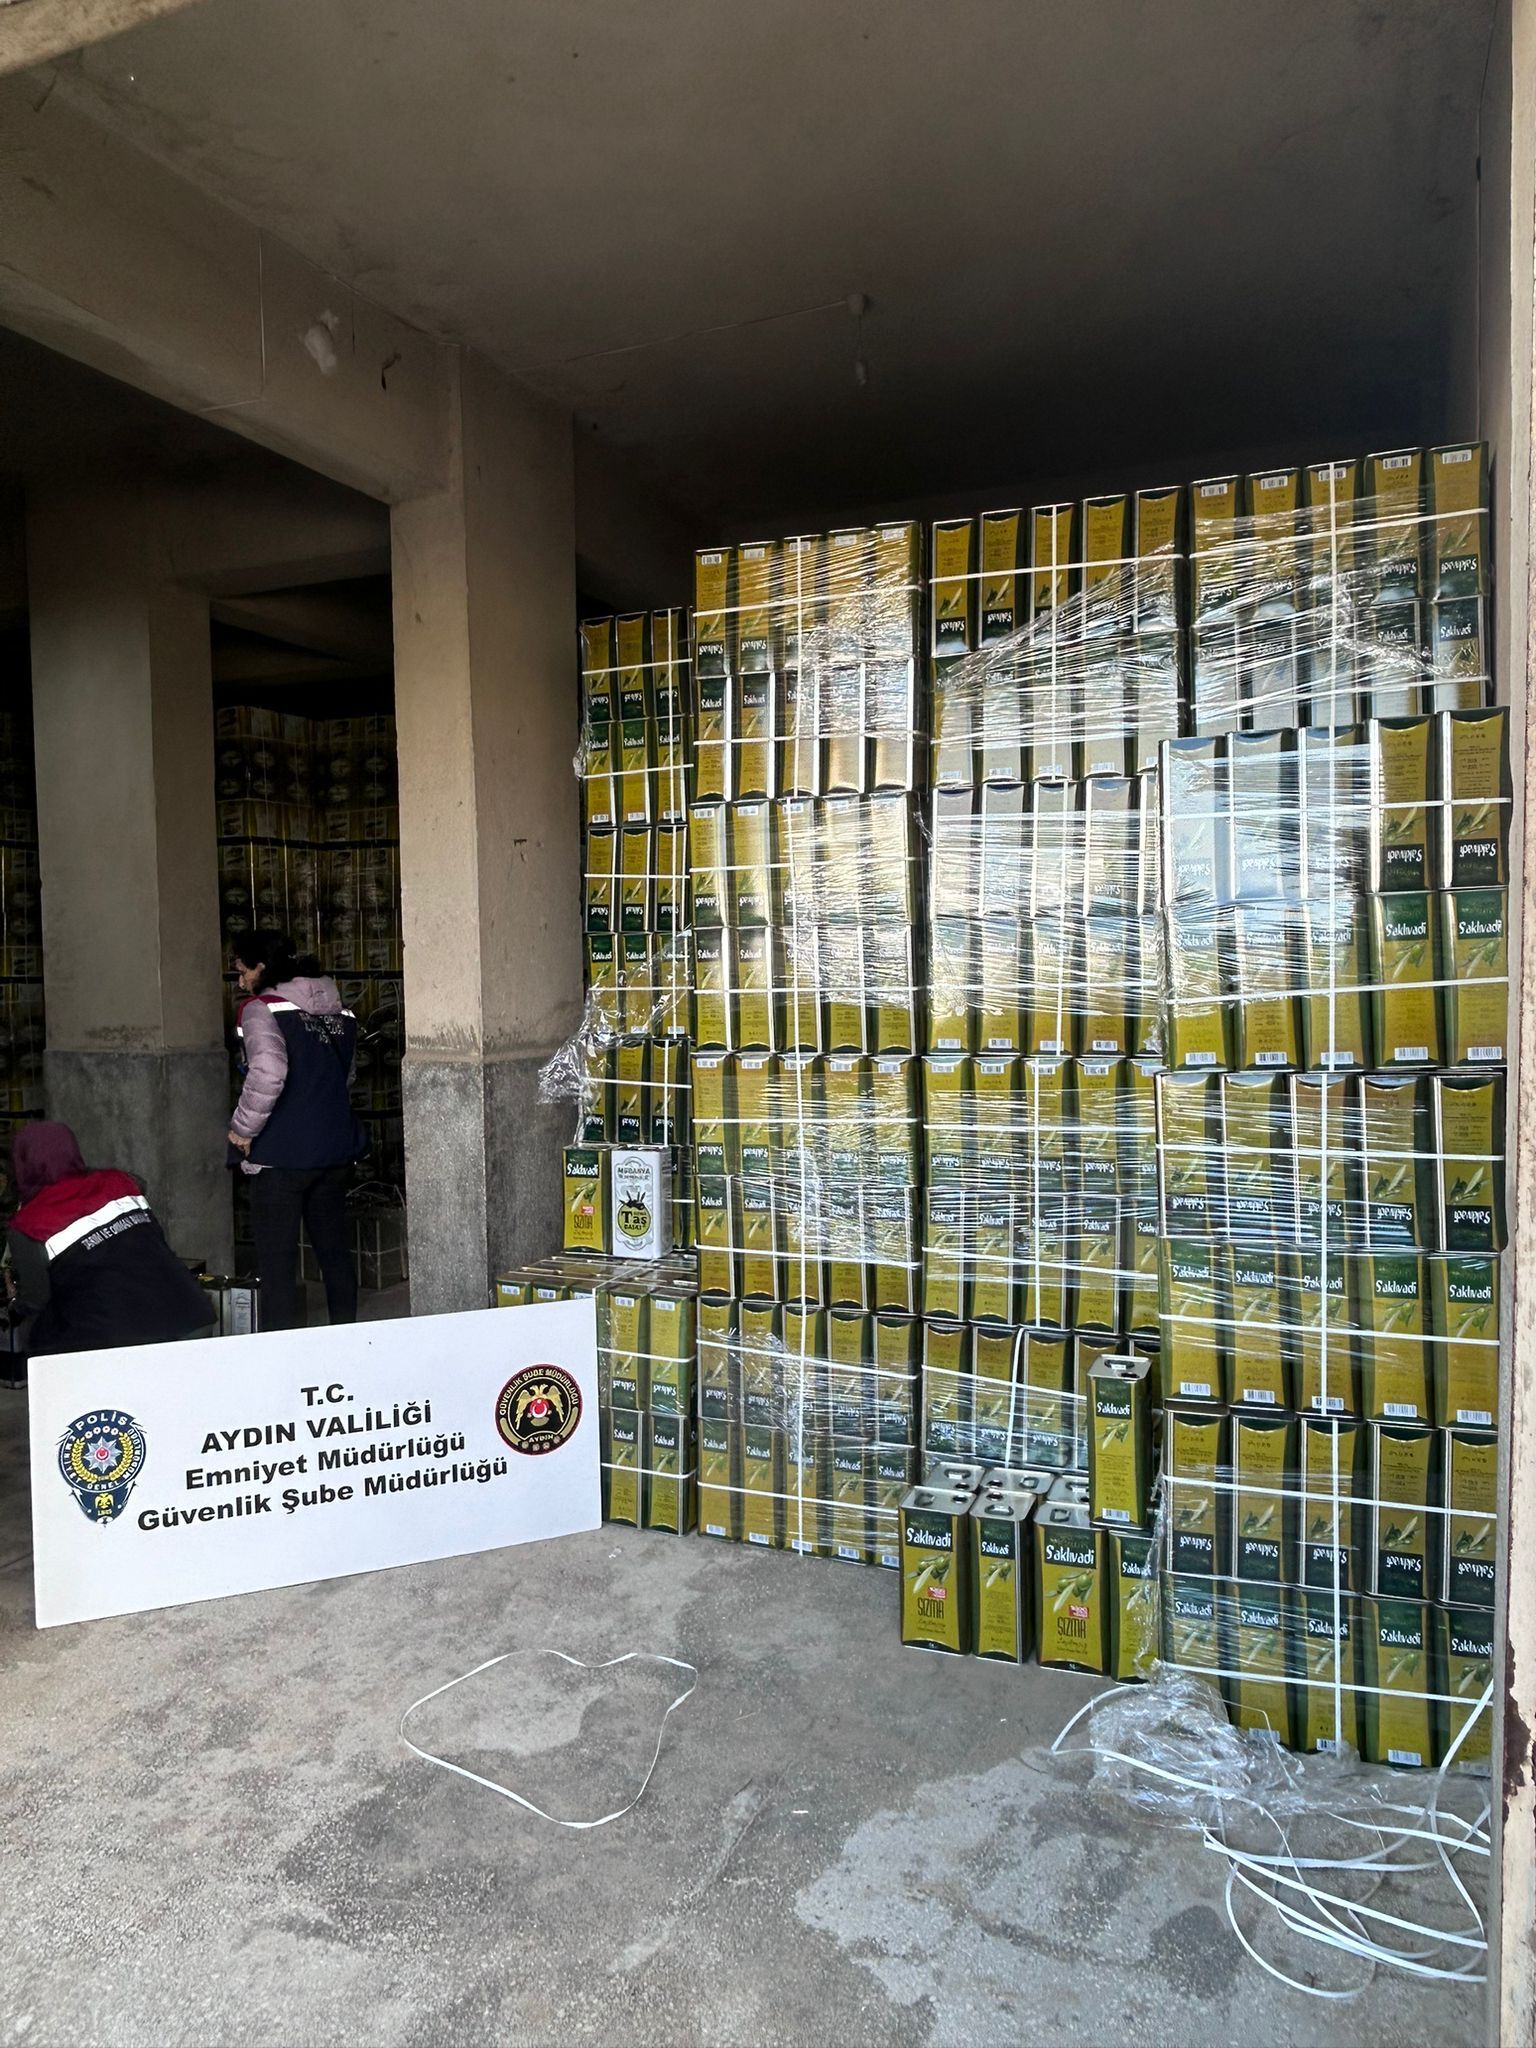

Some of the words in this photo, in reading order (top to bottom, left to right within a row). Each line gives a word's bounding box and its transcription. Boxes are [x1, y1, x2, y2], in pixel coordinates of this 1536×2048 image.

[75, 1411, 127, 1430] POLİS
[301, 1384, 353, 1406] T.C.
[202, 1423, 295, 1453] AYDIN
[307, 1400, 431, 1439] VALİLİĞİ
[187, 1455, 307, 1489] Emniyet
[318, 1432, 466, 1469] Müdürlüğü
[138, 1494, 271, 1530] Güvenlik
[282, 1485, 353, 1514] Şube
[365, 1457, 507, 1496] Müdürlüğü
